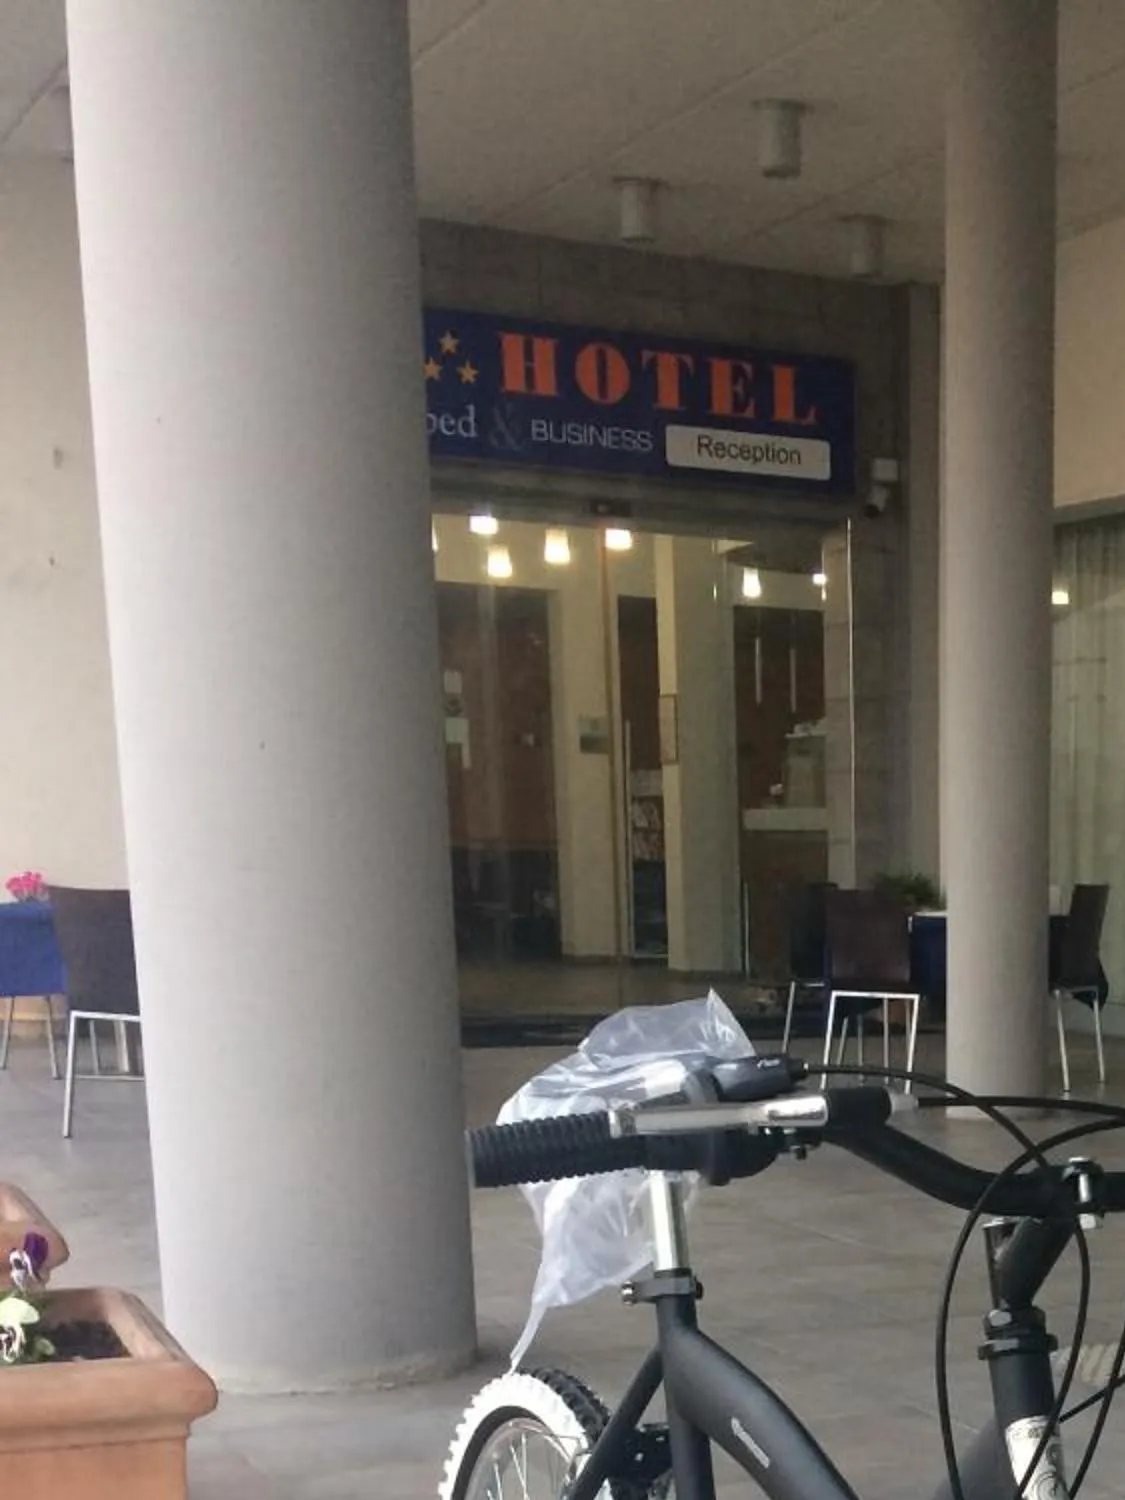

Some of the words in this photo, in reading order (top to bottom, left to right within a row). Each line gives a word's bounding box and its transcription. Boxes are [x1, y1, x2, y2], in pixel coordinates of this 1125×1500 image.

[497, 331, 818, 425] HOTEL
[530, 418, 654, 452] BUSINESS
[697, 434, 802, 466] Reception
